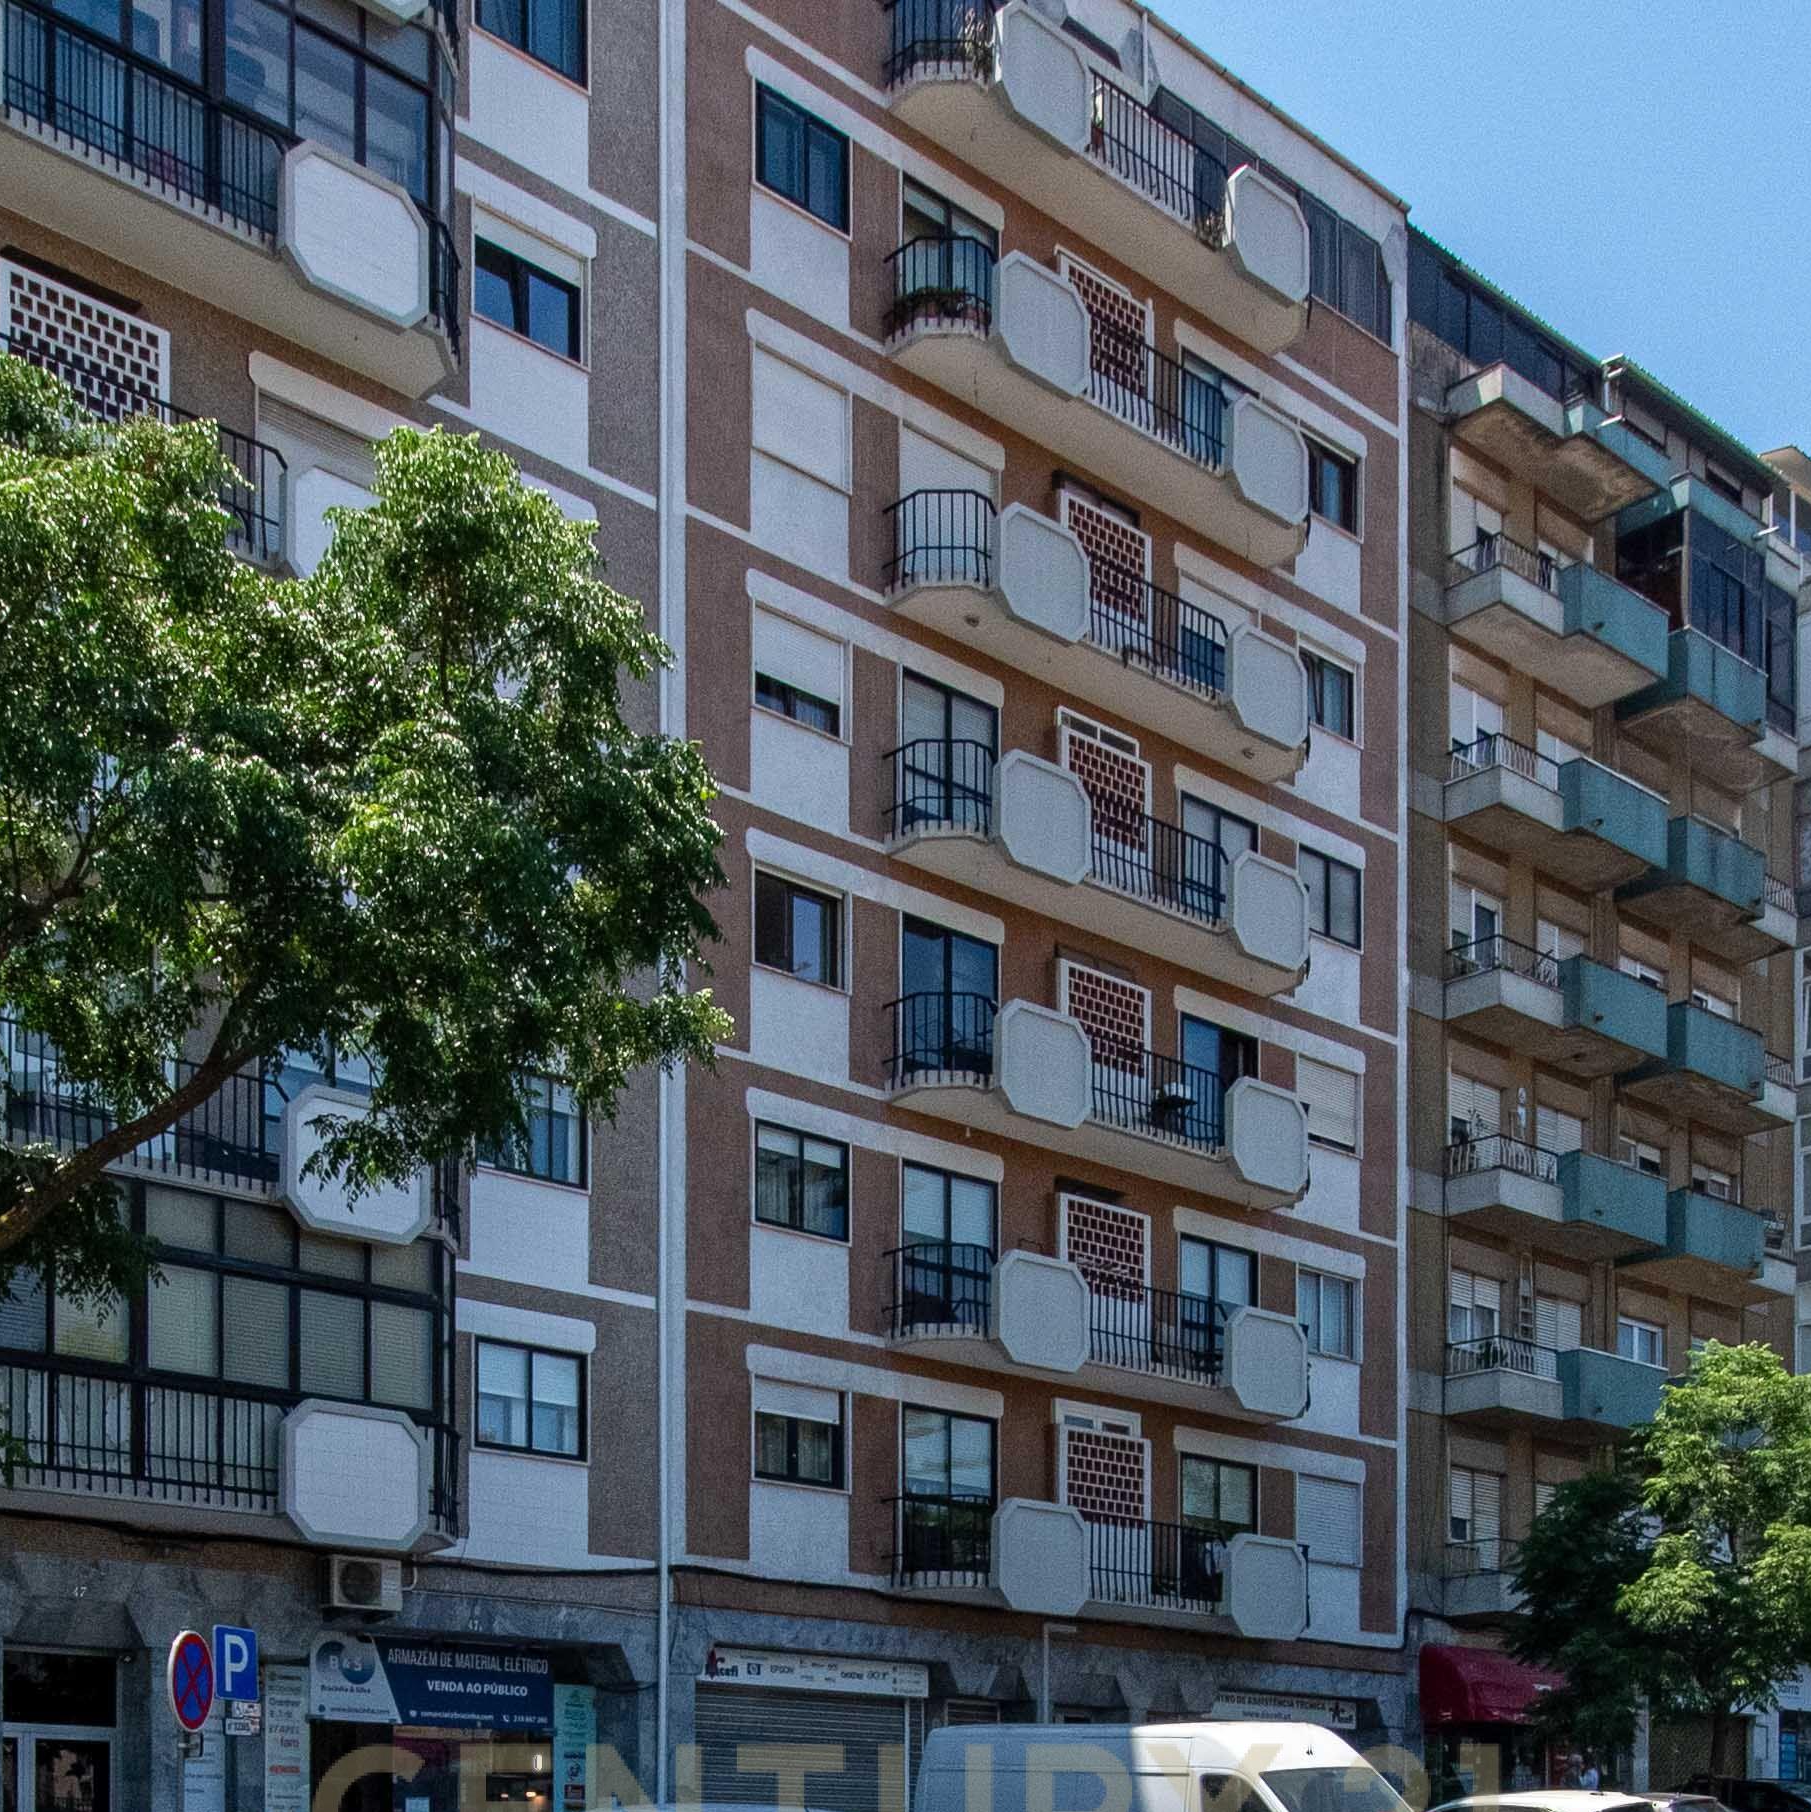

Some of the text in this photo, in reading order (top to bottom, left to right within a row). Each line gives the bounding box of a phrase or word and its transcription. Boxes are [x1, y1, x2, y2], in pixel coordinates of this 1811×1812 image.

[72, 1586, 88, 1598] 47
[224, 1634, 249, 1693] P
[387, 1647, 549, 1675] ARMAZÉM DE MATERIAL ELÉTRICO
[427, 1680, 529, 1697] VENDA AO PÚBLICO
